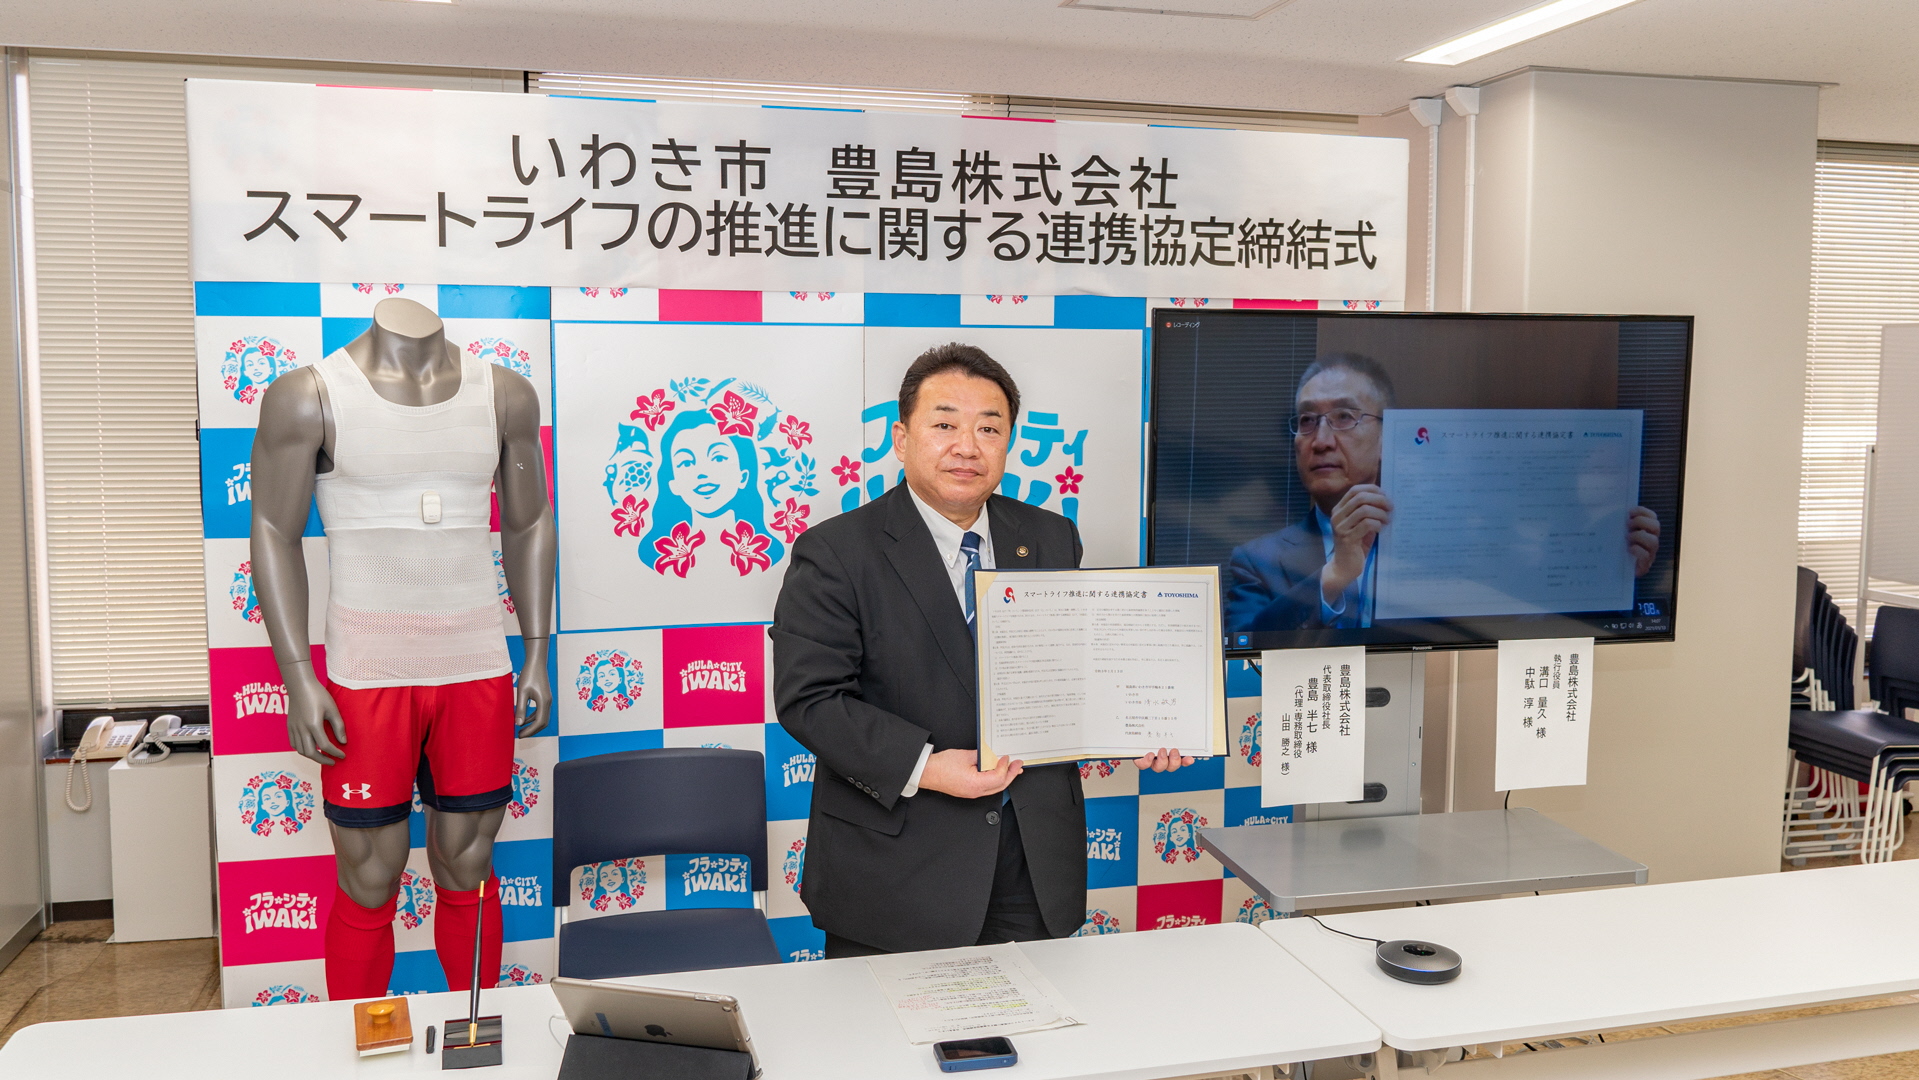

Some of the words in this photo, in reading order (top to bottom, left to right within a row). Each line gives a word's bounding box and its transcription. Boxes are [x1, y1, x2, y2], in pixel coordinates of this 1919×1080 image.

[512, 134, 771, 196] いわき市
[826, 144, 1178, 210] 豊島株式会社
[243, 191, 1377, 271] スマートライフの推進に関する連携協定締結式
[687, 660, 714, 673] HULA
[720, 661, 742, 672] CITY
[1539, 666, 1549, 689] 溝口
[1552, 654, 1562, 689] 執行役員
[1307, 677, 1319, 701] 豊島
[1322, 665, 1331, 730] 代表取締役社長
[1566, 653, 1579, 722] 豊島株式会社
[1339, 664, 1351, 736] 豊島株式会社
[1281, 713, 1290, 731] 山田
[1306, 709, 1318, 733] 半七
[1523, 716, 1533, 728] 様
[1536, 727, 1546, 739] 様
[1306, 741, 1317, 753] 様
